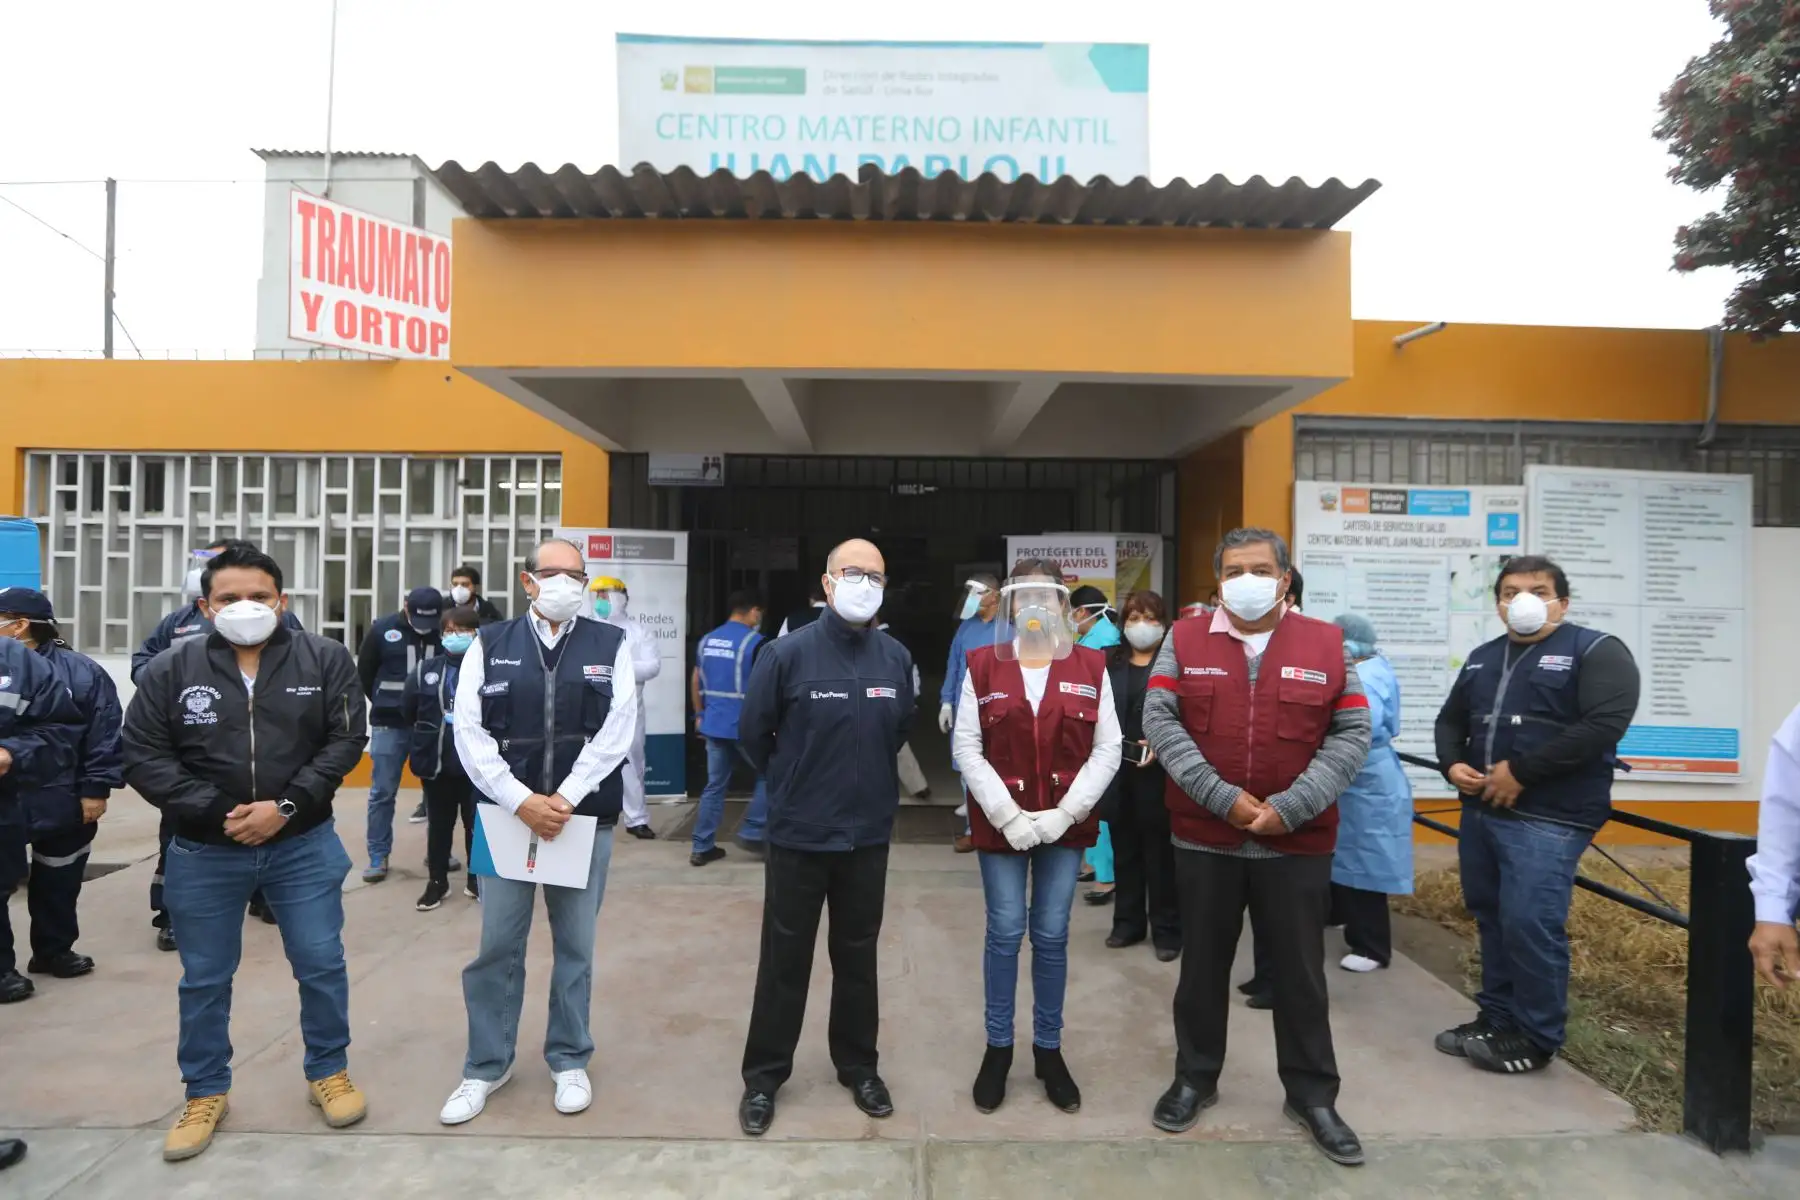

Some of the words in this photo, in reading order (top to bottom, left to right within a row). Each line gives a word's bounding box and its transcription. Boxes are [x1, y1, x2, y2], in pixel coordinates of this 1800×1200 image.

[655, 113, 786, 141] CENTRO
[797, 114, 962, 143] MATERNO
[973, 116, 1118, 145] INFANTIL
[298, 199, 450, 313] TRAUMATO
[301, 291, 324, 332] Y
[334, 300, 449, 357] ORTOP
[590, 542, 610, 552] PERÚ
[1086, 547, 1107, 558] DEL
[640, 612, 674, 624] Redes
[653, 628, 678, 639] alud
